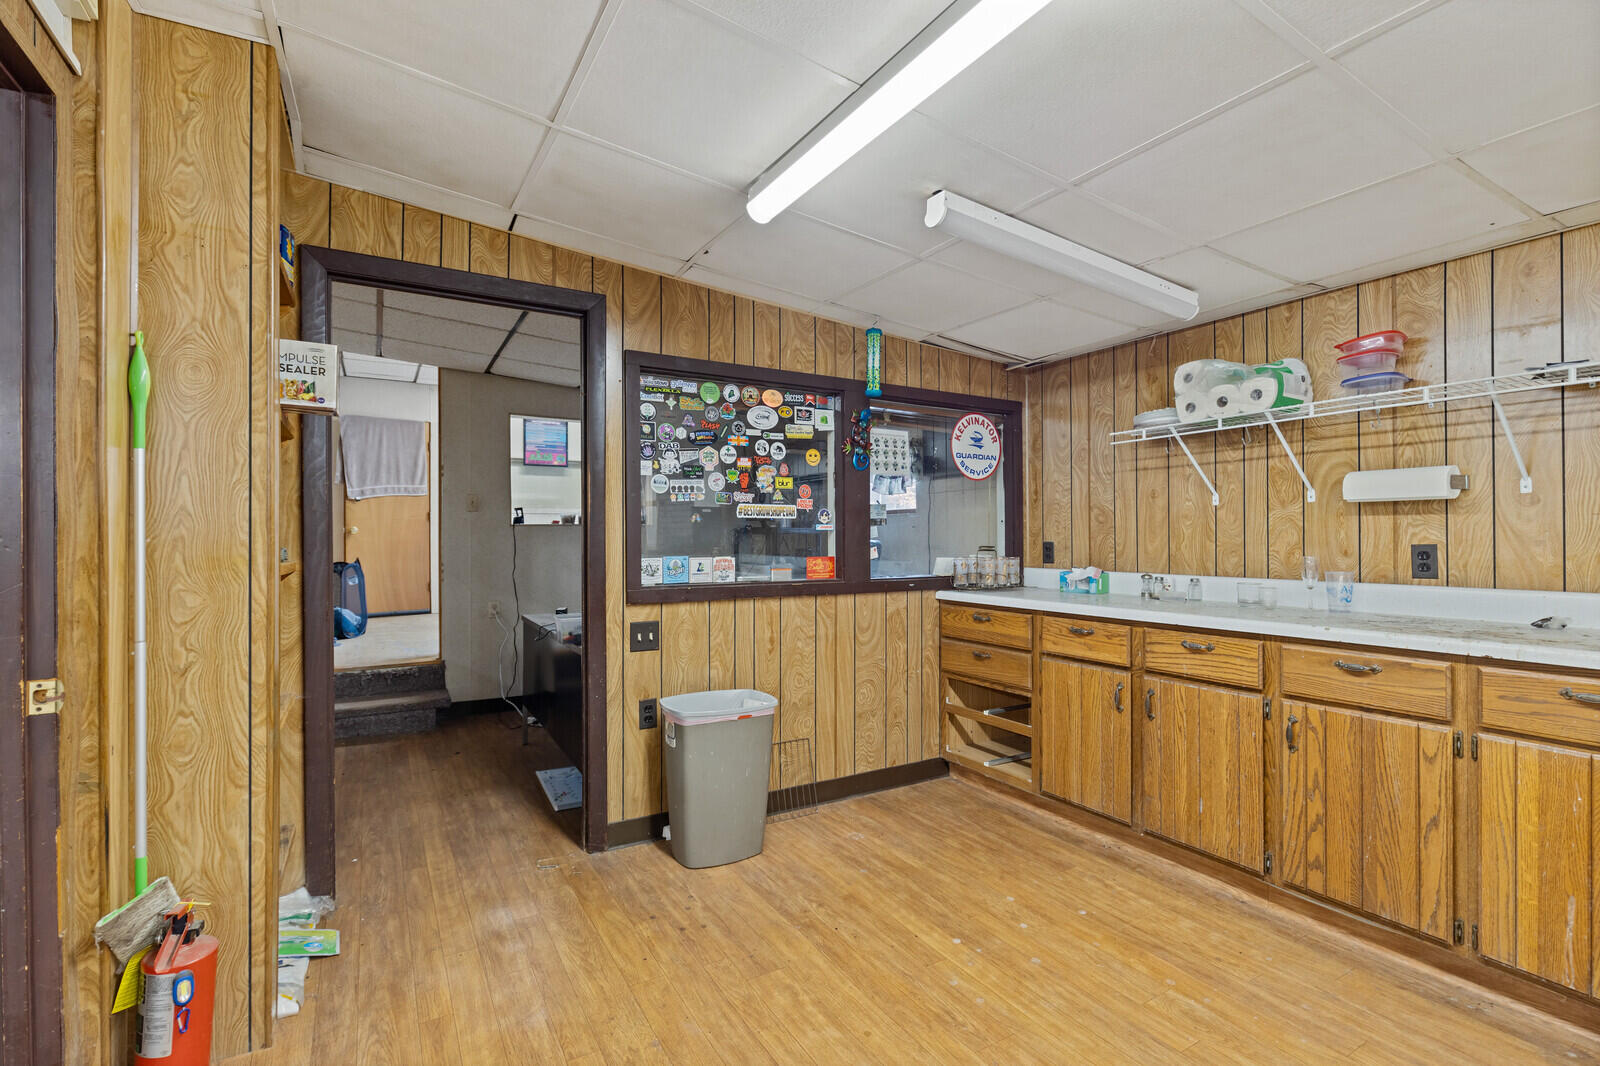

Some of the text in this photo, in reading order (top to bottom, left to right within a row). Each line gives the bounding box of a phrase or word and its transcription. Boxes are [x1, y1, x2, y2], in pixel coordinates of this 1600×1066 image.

[280, 353, 326, 366] MPULSE
[280, 363, 326, 376] SEALER
[784, 394, 804, 402] SUCCESS
[954, 416, 998, 444] KELVINATOR
[955, 452, 997, 462] GUARDIAN
[959, 459, 994, 476] SERVICE
